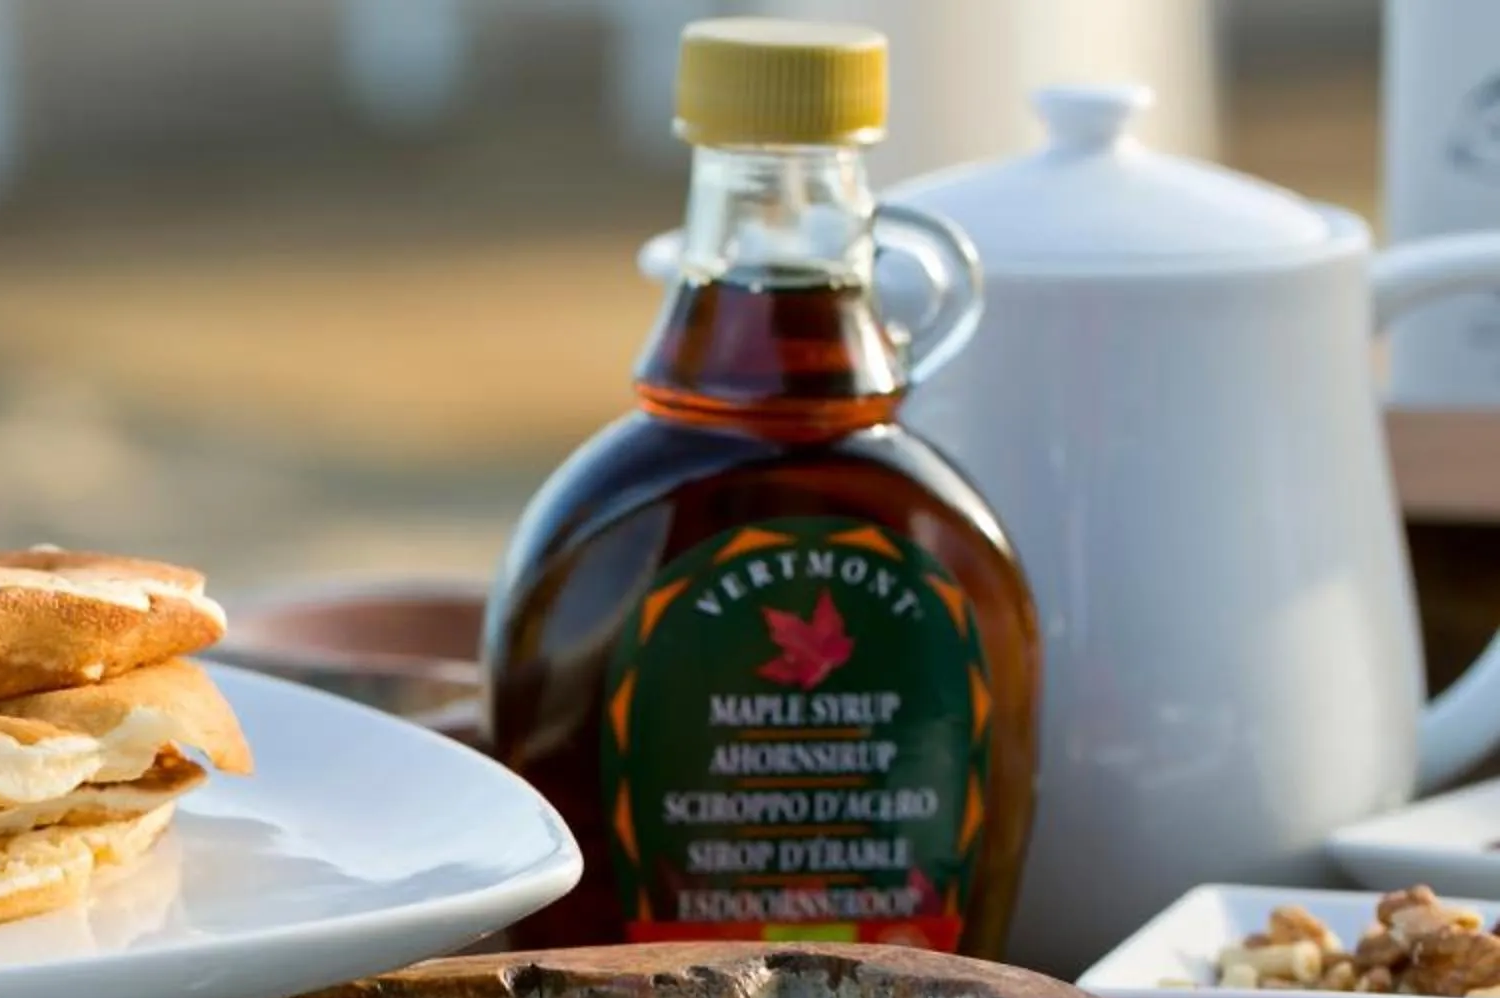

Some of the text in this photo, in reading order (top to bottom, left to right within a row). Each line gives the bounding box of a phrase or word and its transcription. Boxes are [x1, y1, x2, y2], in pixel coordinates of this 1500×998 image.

[695, 549, 921, 618] VERTMONT
[709, 691, 901, 726] MAPLE SYRUP
[709, 741, 898, 776] AHORNSIRUP
[664, 790, 809, 824] SCIROPPO
[687, 839, 775, 873] SIROP
